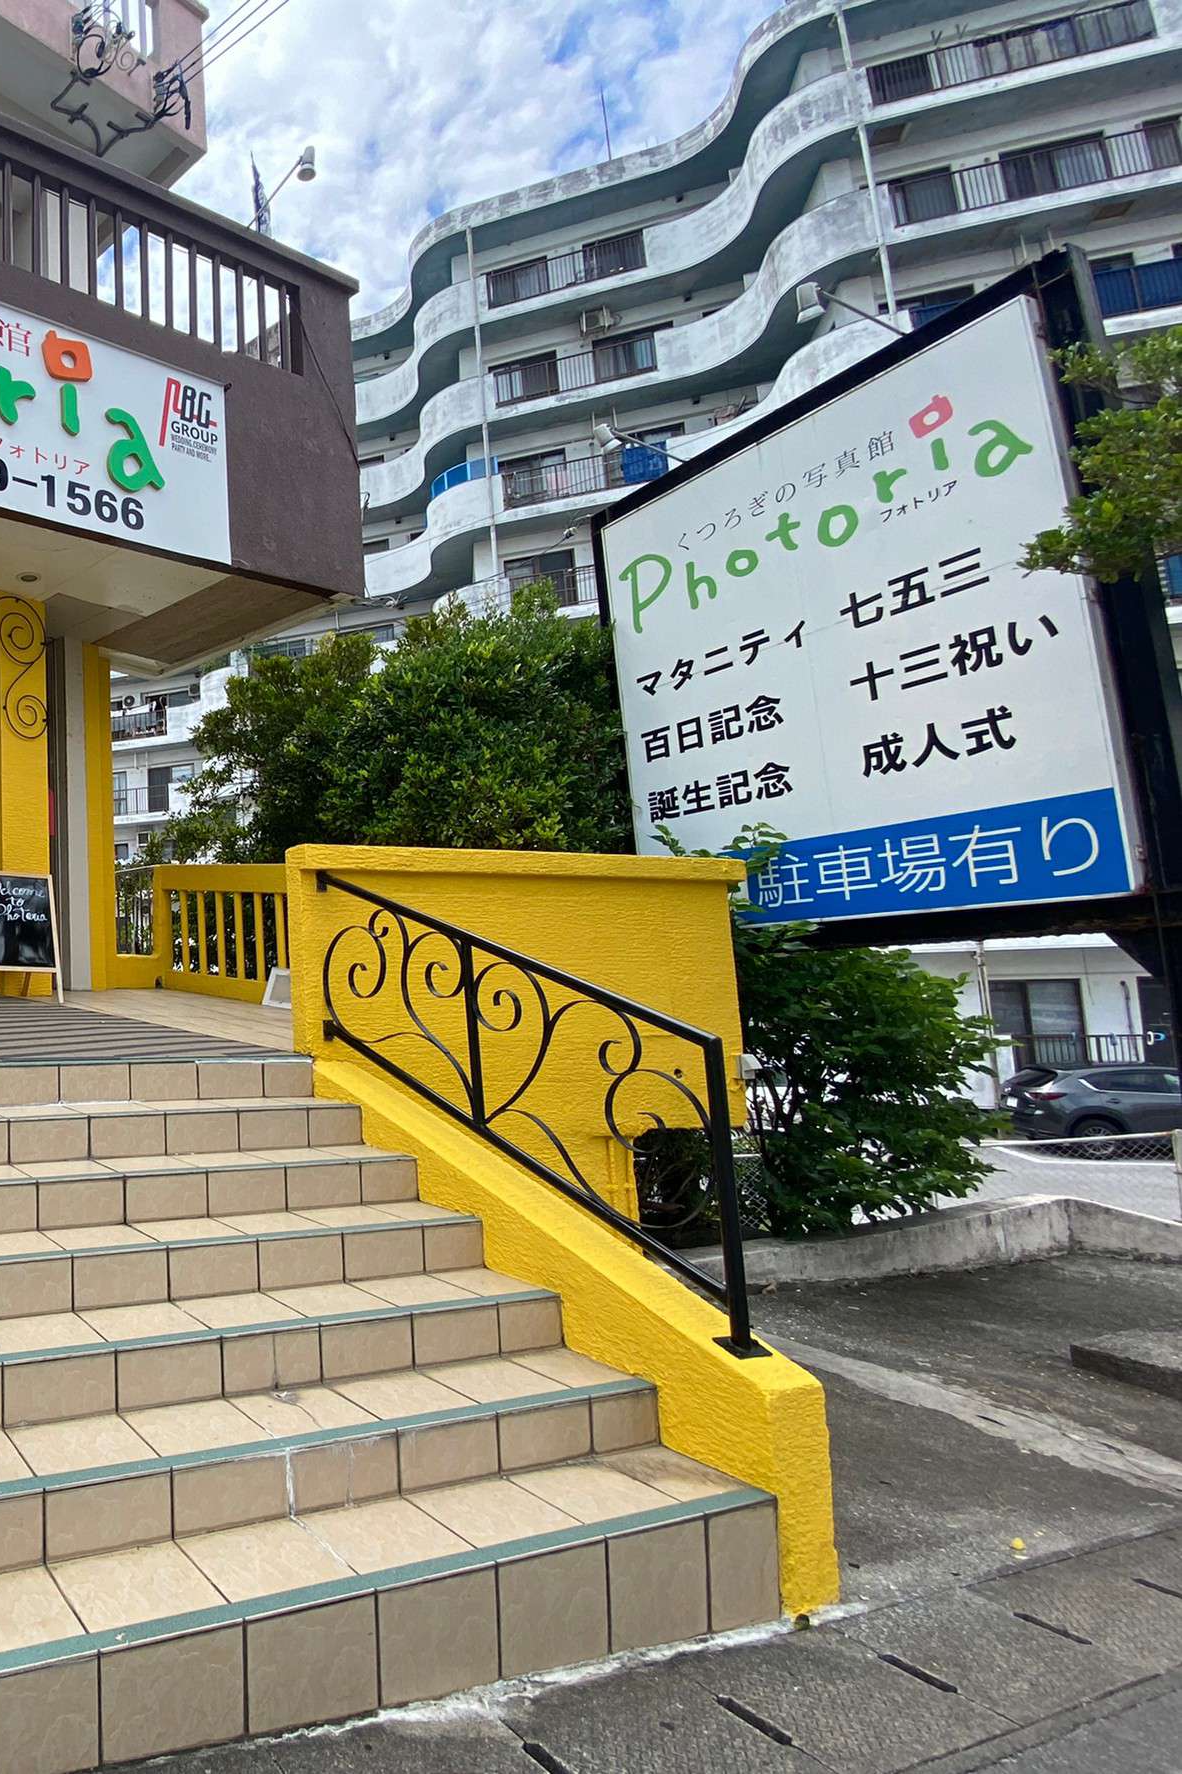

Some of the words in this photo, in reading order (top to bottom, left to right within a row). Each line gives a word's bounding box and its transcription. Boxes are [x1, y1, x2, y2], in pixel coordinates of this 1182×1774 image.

[171, 420, 218, 445] GROUP
[618, 396, 1034, 634] Photoria
[676, 430, 896, 552] くつろぎの写真館
[879, 479, 958, 524] フォトリア
[840, 546, 991, 630] 七五三
[635, 619, 808, 698] マタニティ
[849, 614, 1059, 702] 十三祝い
[640, 694, 785, 763] 百日記念
[861, 705, 1017, 778] 成人式
[647, 761, 795, 823] 誕生記念
[757, 815, 1100, 908] 駐車場有り
[5, 896, 25, 906] to
